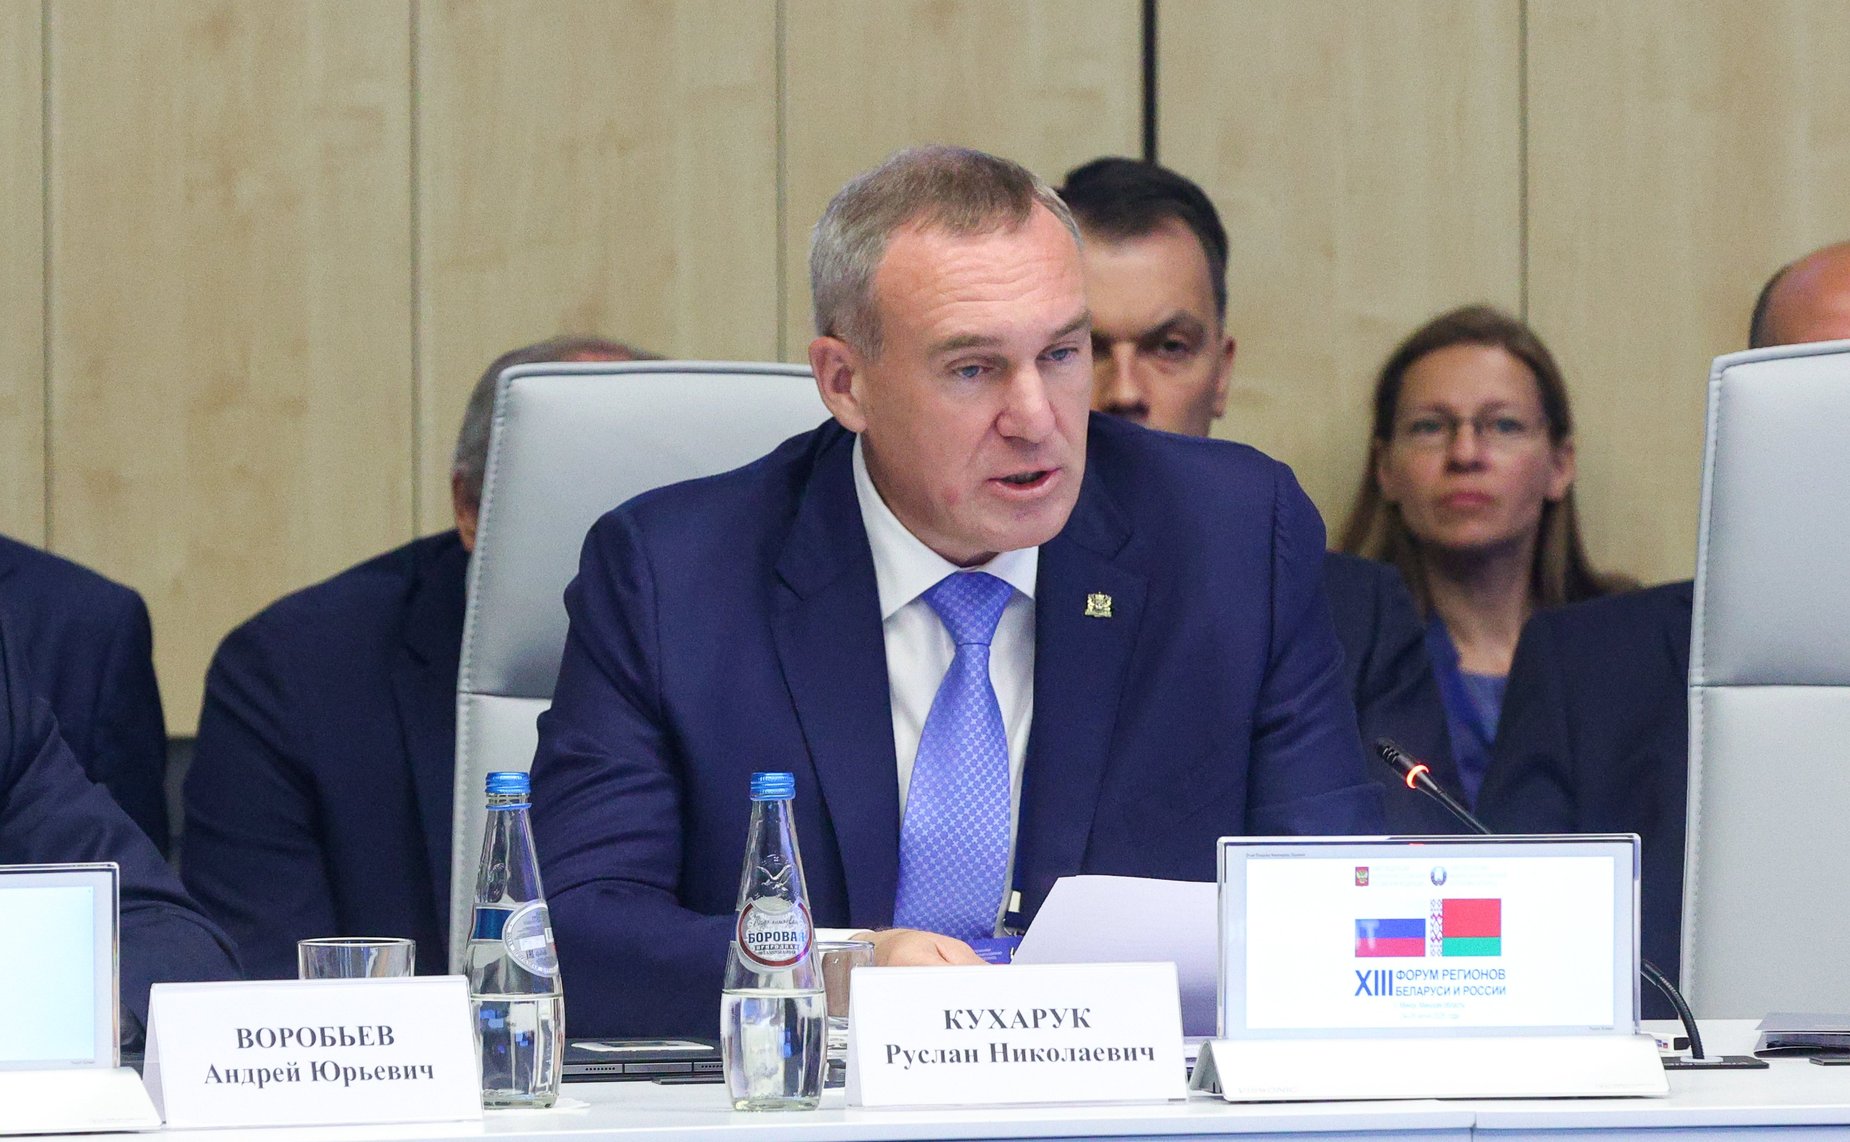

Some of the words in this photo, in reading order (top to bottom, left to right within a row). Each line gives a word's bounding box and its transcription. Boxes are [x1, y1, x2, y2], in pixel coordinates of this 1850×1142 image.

[1354, 969, 1393, 997] XIII
[1395, 968, 1439, 981] ФОРУМ
[1441, 968, 1507, 981] РЕГИОНОВ
[1395, 985, 1451, 997] БЕЛАРУСИ
[1453, 985, 1461, 996] И
[1463, 985, 1507, 996] РОССИИ
[944, 1007, 1091, 1030] КУХАРУК
[236, 1025, 395, 1049] ВОРОБЬЕВ
[886, 1043, 979, 1070] Руслан
[989, 1042, 1155, 1063] Николаевич
[204, 1061, 301, 1089] Андрей
[310, 1060, 434, 1088] Юрьевич
